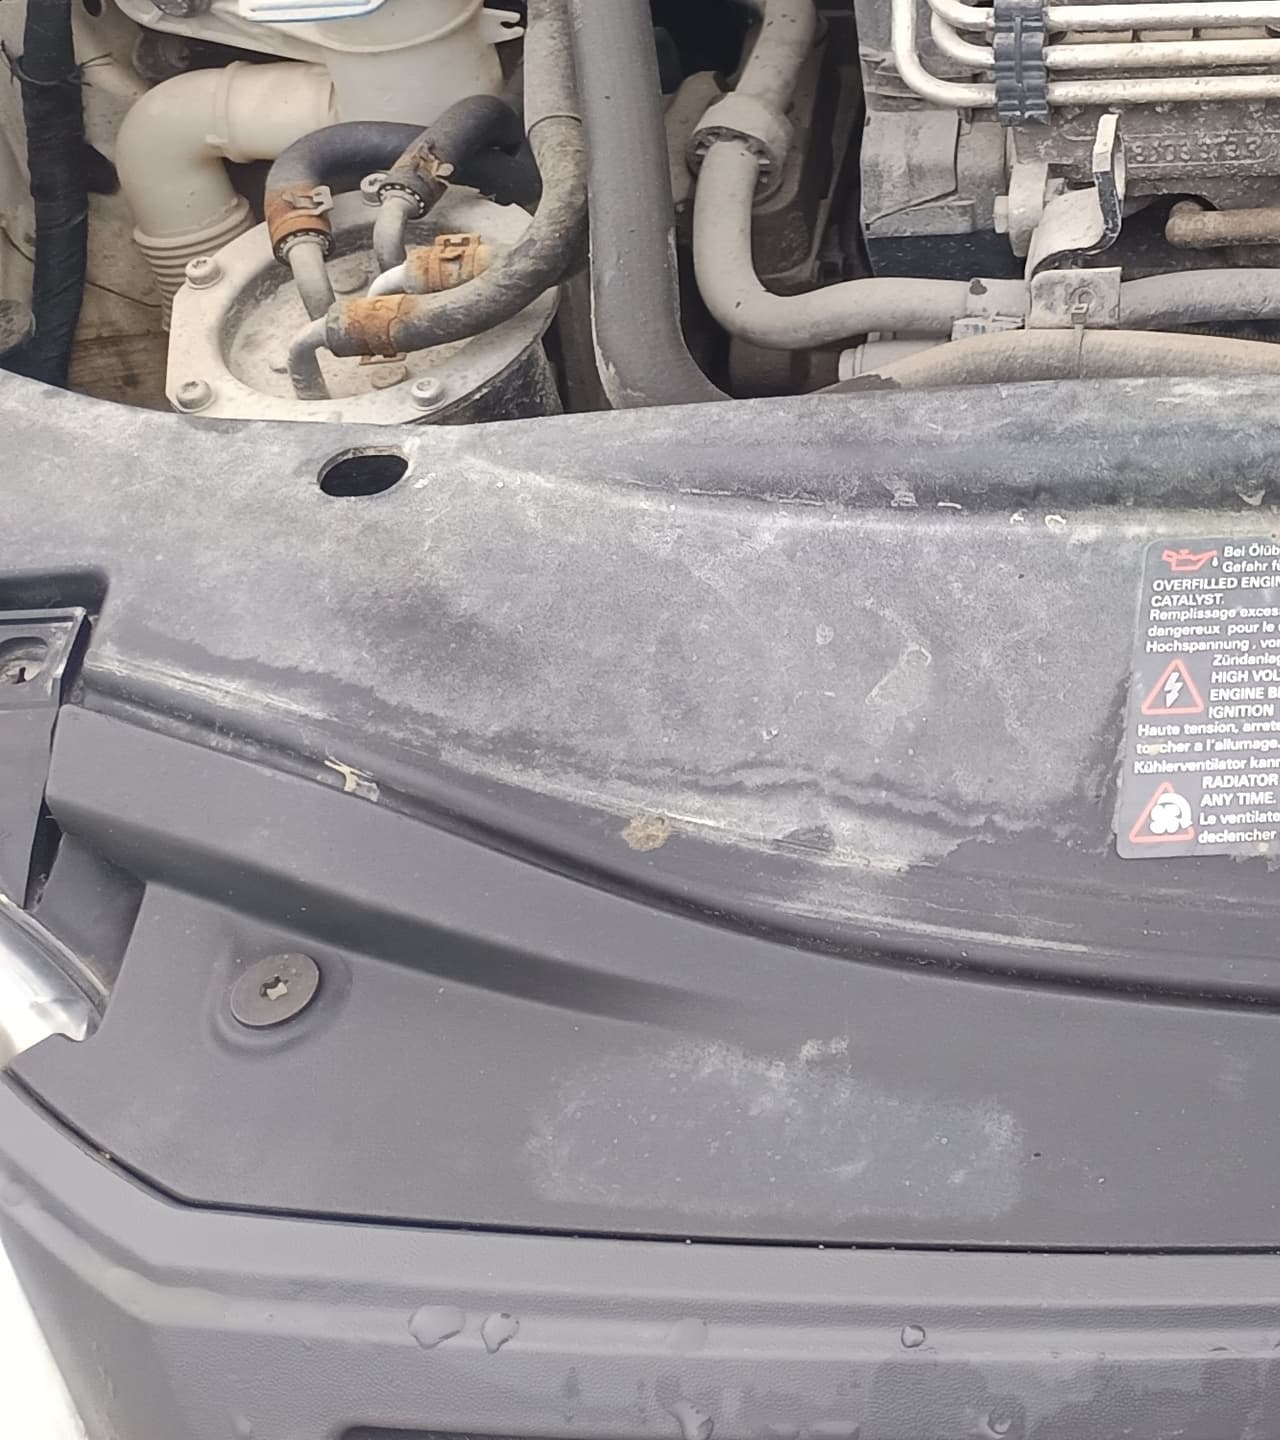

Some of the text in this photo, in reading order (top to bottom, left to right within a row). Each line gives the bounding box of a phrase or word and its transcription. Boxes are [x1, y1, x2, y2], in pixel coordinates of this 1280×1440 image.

[1223, 545, 1245, 557] Bei
[1222, 561, 1268, 573] Gefahr
[1153, 577, 1238, 591] OVERFILLED
[1151, 593, 1225, 607] CATALYST.
[1150, 608, 1236, 621] Remplissage
[1148, 625, 1220, 638] dangereux
[1227, 624, 1259, 636] pour
[1262, 621, 1275, 633] le
[1146, 640, 1249, 653] Hochspannung
[1211, 670, 1248, 683] HIGH
[1210, 687, 1264, 701] ENGINE
[1208, 704, 1274, 719] IGNITION
[1138, 724, 1180, 736] Haute
[1184, 722, 1239, 735] tension,
[1136, 738, 1280, 755] tocher a l'allumage.
[1134, 759, 1247, 774] Kühlerventilator
[1202, 774, 1278, 789] RADIATOR
[1200, 792, 1276, 807] ANY TIME.
[1200, 813, 1216, 825] Le
[1198, 829, 1276, 843] declencher
